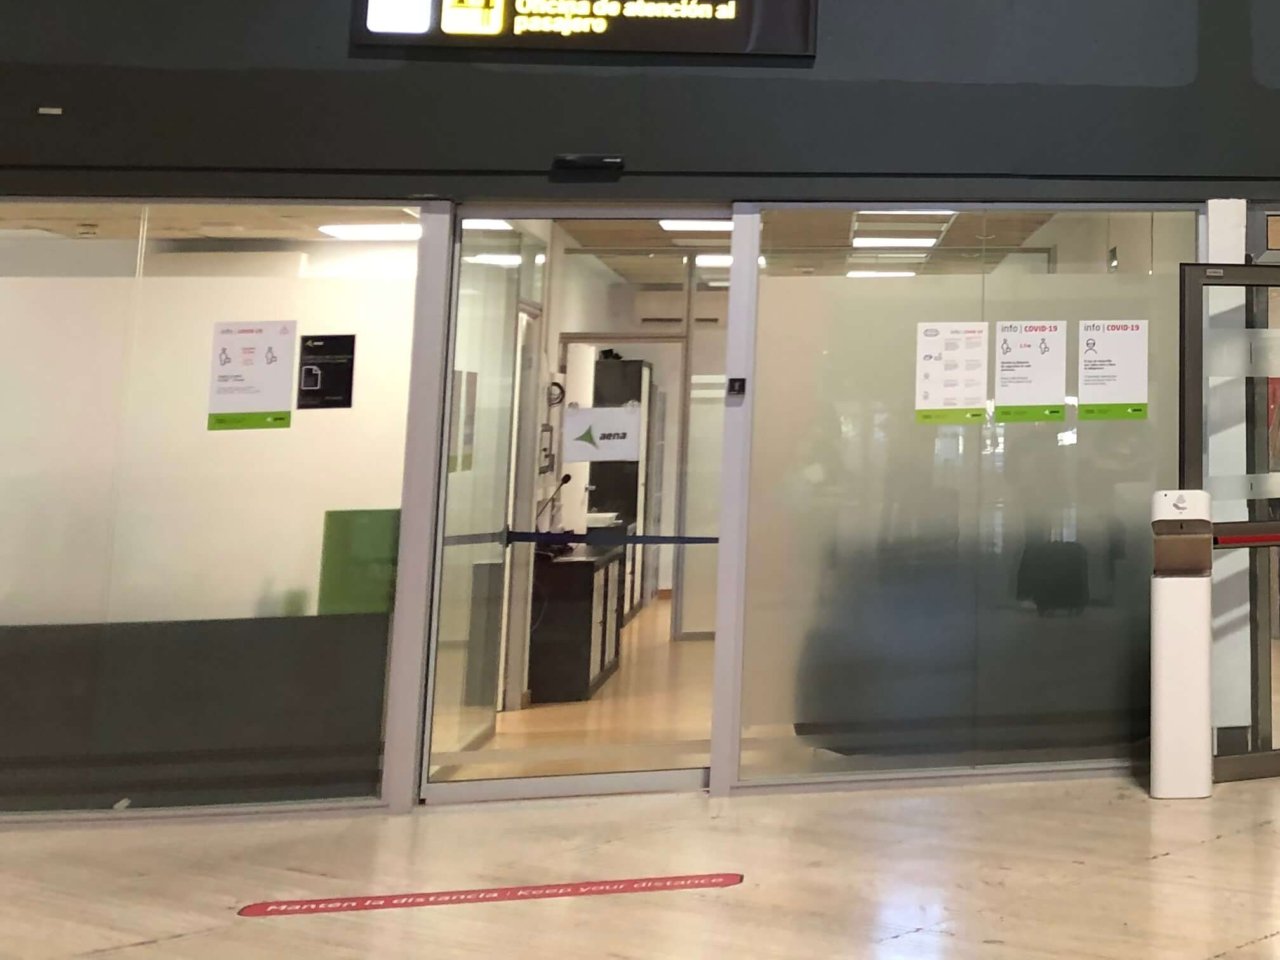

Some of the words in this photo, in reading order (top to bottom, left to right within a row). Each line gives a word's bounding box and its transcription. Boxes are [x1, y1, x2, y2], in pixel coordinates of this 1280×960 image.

[715, 0, 736, 19] al
[514, 14, 608, 36] pasajero
[1001, 325, 1019, 333] info
[599, 432, 627, 440] aena
[391, 892, 499, 904] distancia
